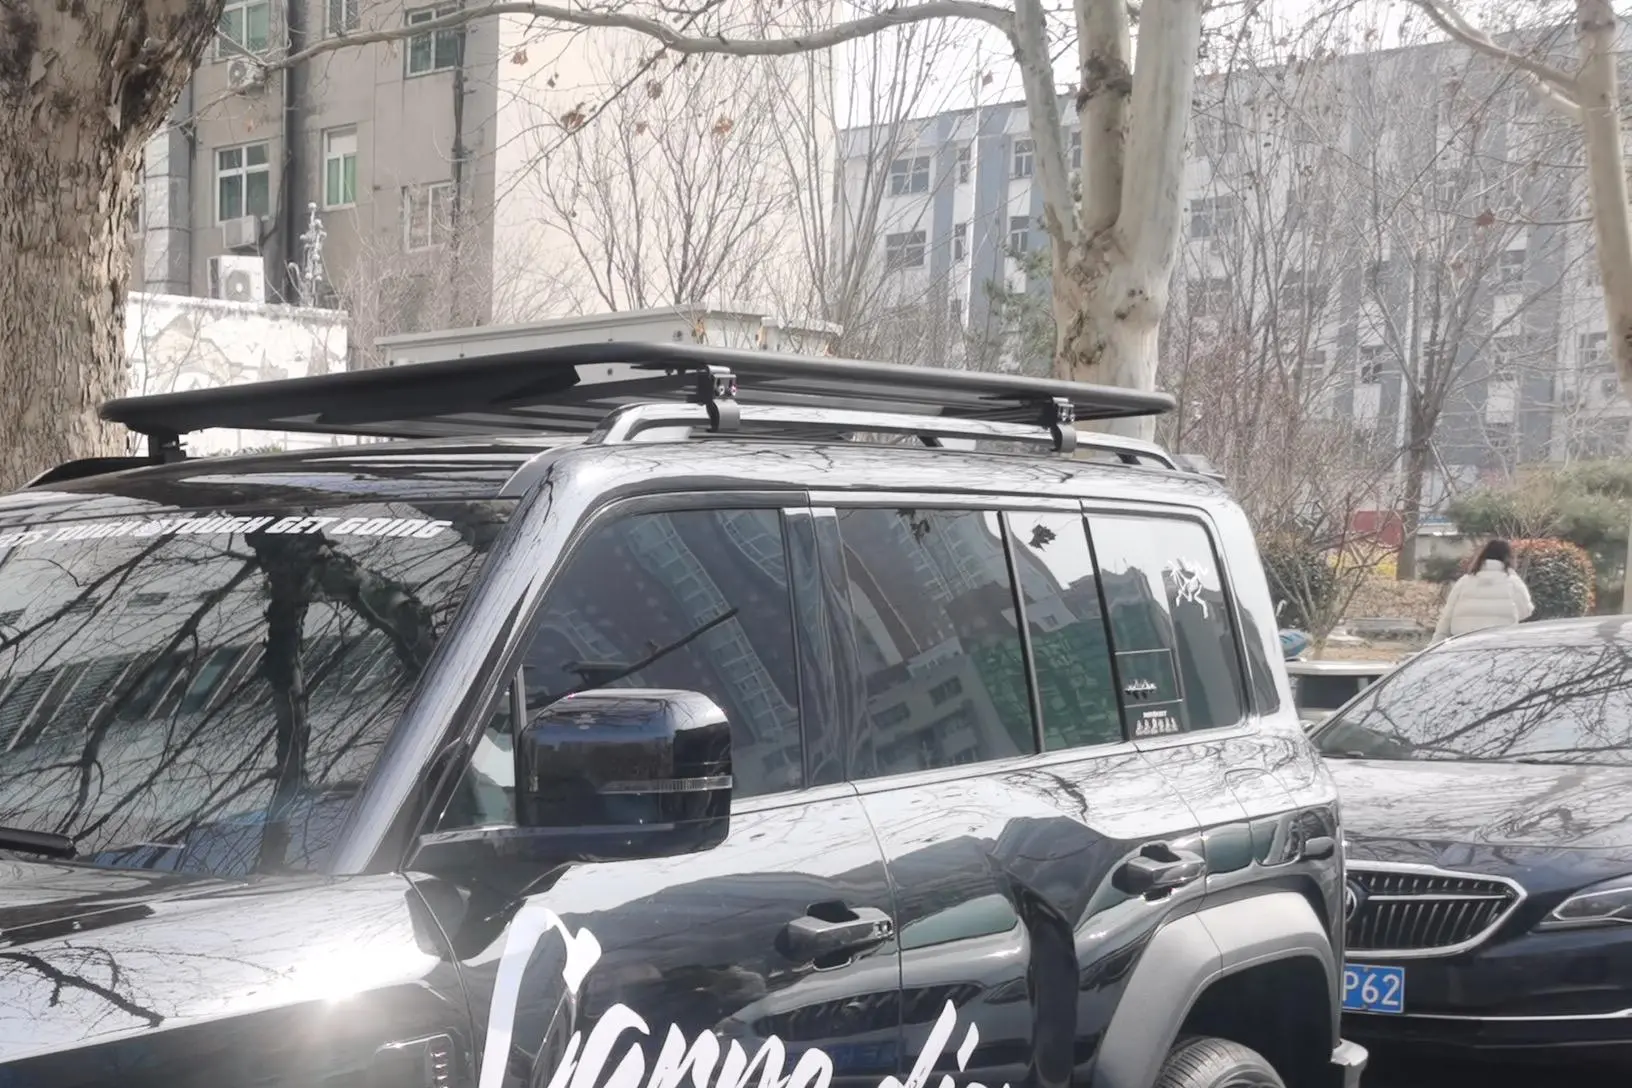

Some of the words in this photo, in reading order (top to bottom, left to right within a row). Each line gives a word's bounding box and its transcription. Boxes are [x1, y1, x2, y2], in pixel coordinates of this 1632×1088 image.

[44, 520, 143, 543] TOUGH
[159, 516, 275, 535] TOUGH
[264, 516, 342, 535] GET
[329, 517, 454, 539] GOING
